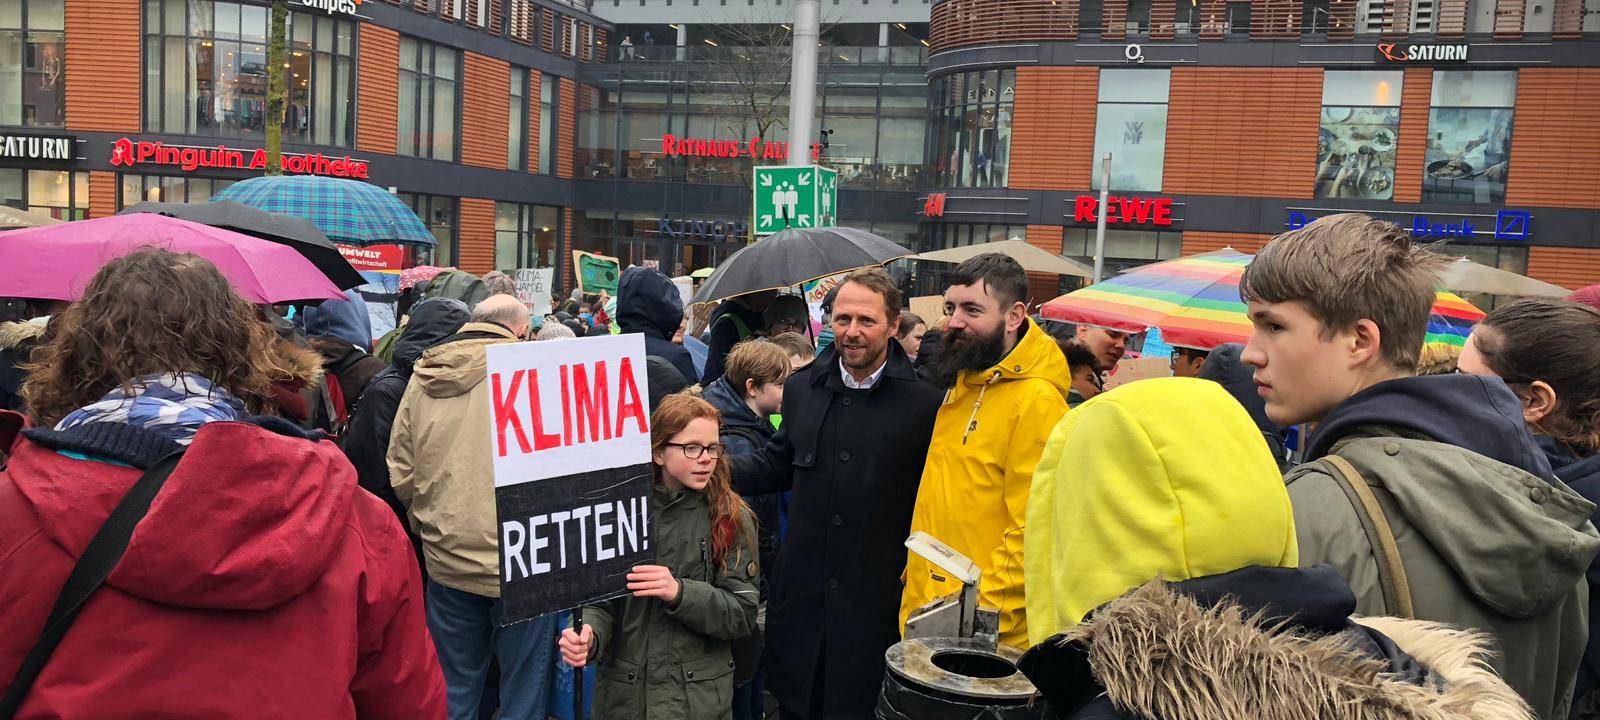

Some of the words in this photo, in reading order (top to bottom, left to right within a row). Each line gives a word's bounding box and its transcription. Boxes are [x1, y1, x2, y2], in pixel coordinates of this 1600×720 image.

[1408, 45, 1468, 60] SATURN
[138, 141, 243, 171] Pinguin
[249, 148, 370, 179] Aotheke
[1074, 194, 1172, 225] REWE
[1412, 217, 1476, 238] Bank
[338, 247, 382, 259] UMWELT
[491, 357, 649, 457] KLIMA
[502, 496, 648, 583] RETTEN!
